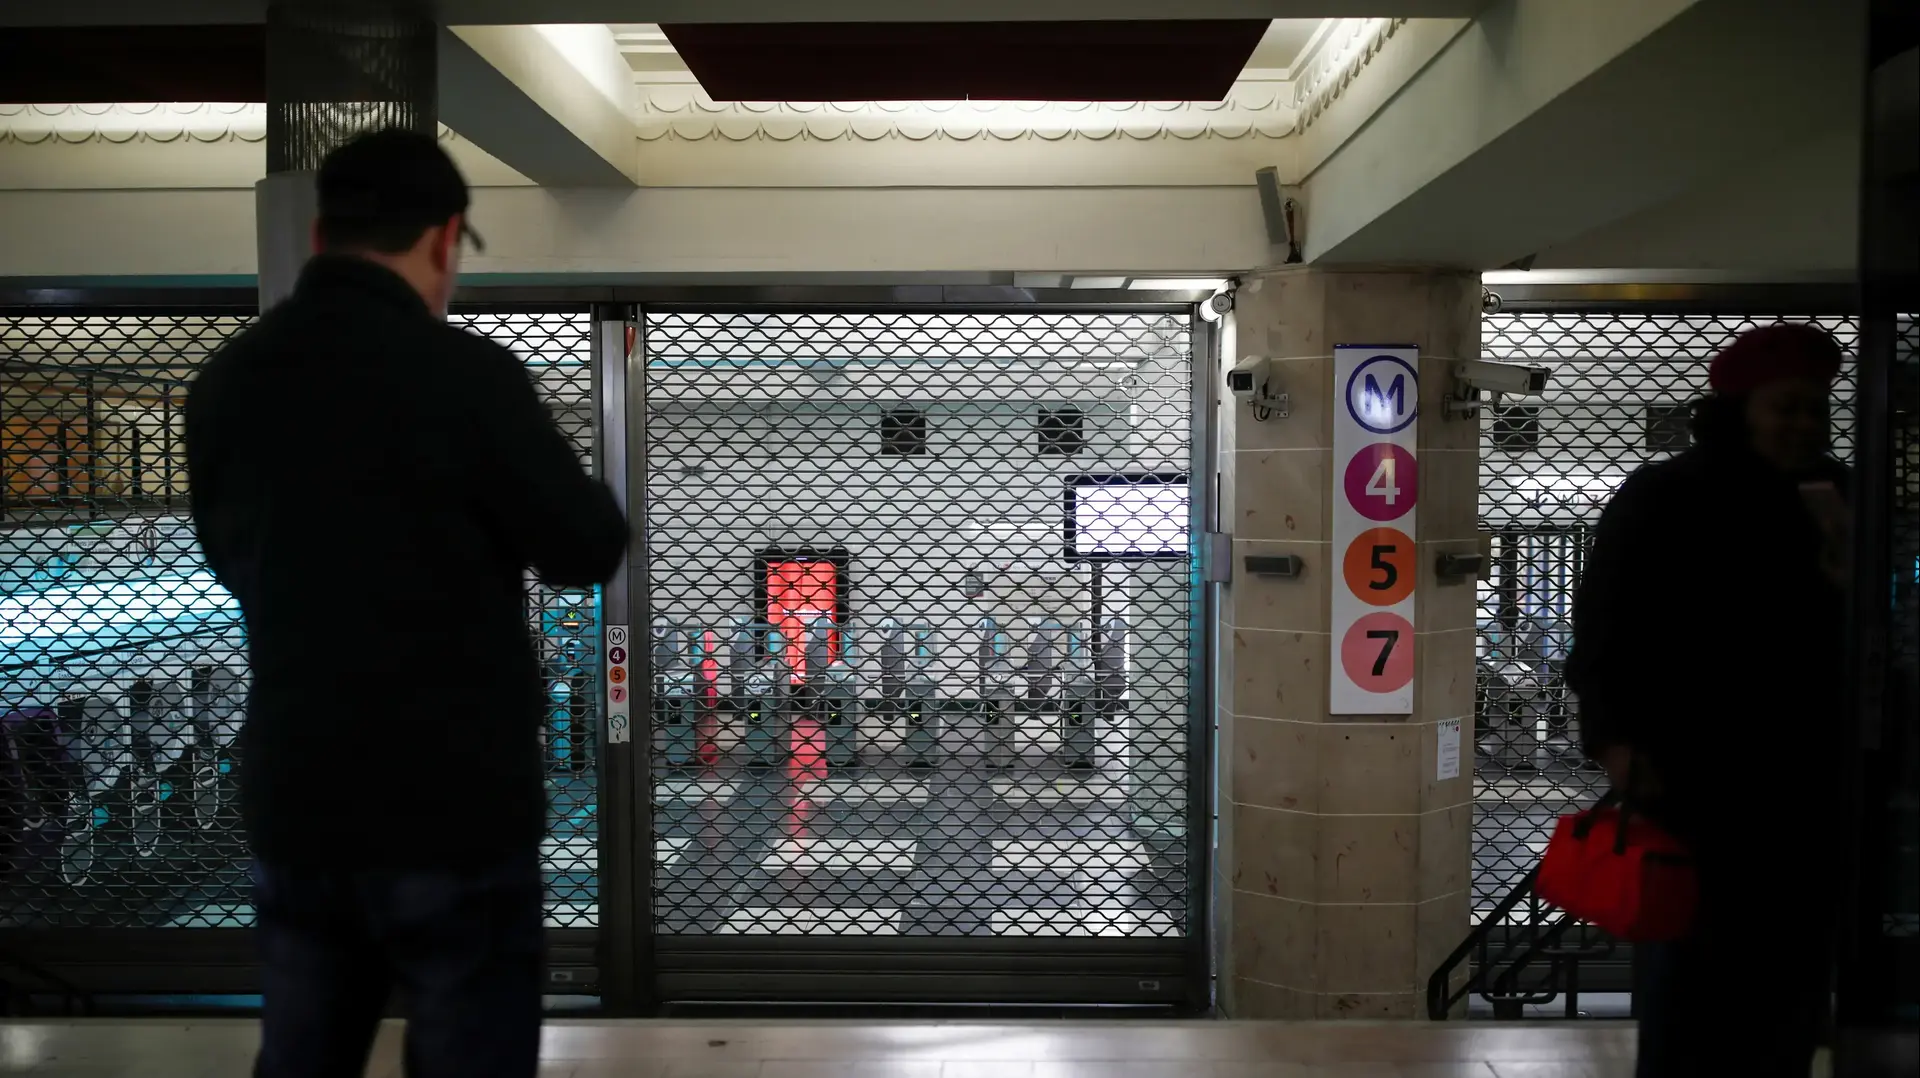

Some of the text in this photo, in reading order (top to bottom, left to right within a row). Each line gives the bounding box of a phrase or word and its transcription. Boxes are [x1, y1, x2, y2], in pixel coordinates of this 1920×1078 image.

[1365, 373, 1405, 416] M
[1365, 458, 1401, 505] 4
[1368, 544, 1398, 590] 5
[612, 631, 622, 641] M
[612, 650, 620, 660] 4
[1366, 630, 1399, 676] 7
[614, 670, 620, 680] 5
[614, 690, 622, 700] 7
